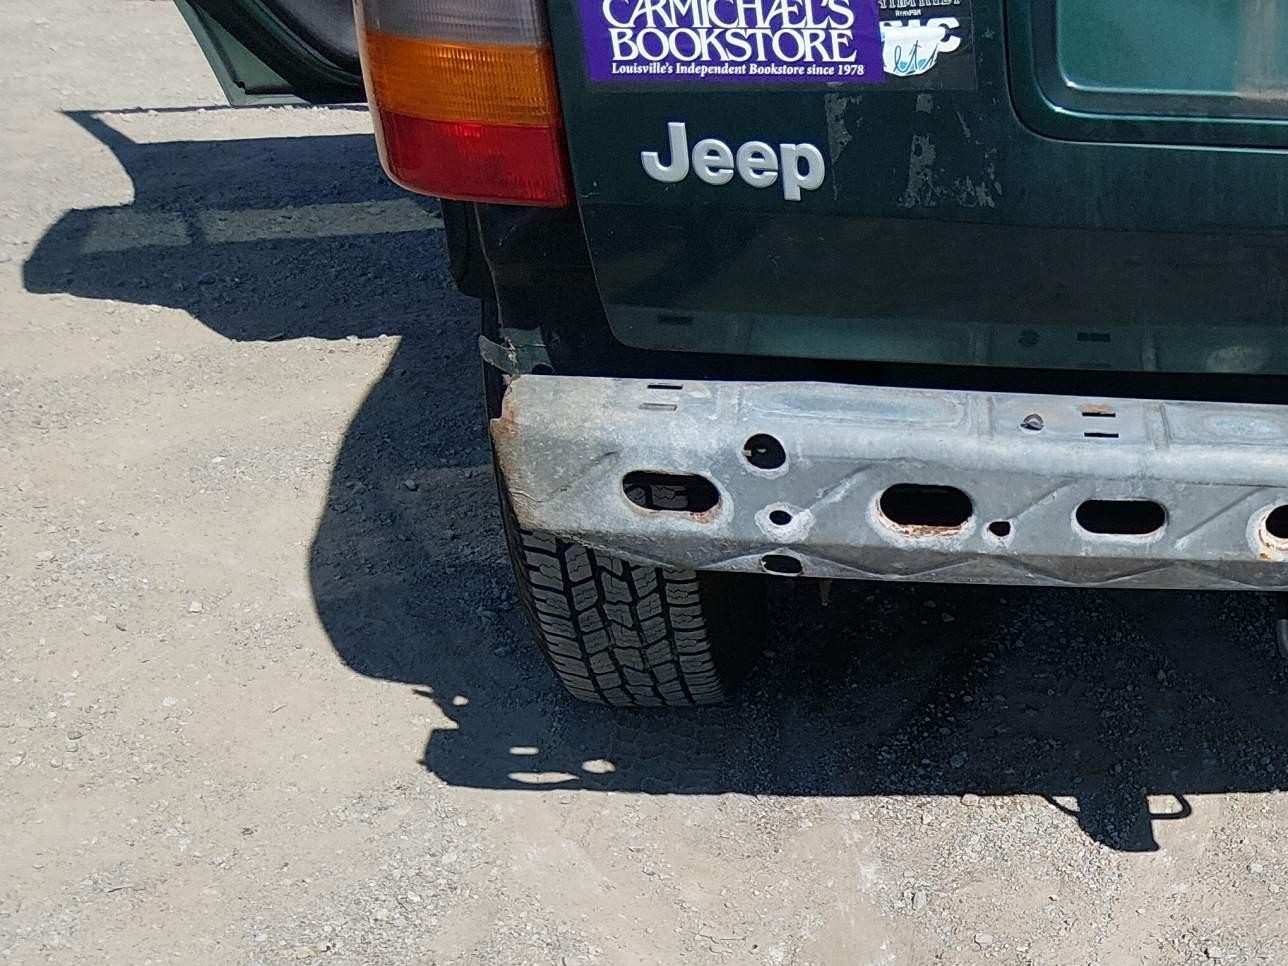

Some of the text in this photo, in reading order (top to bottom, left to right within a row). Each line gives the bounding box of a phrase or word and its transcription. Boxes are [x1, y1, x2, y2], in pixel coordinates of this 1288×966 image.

[603, 0, 855, 29] CARMICHAEL'S
[608, 27, 857, 62] BOOKSTORE
[612, 62, 865, 78] Louisville's Independent Bookstore since 1978
[641, 121, 826, 201] Jeep
